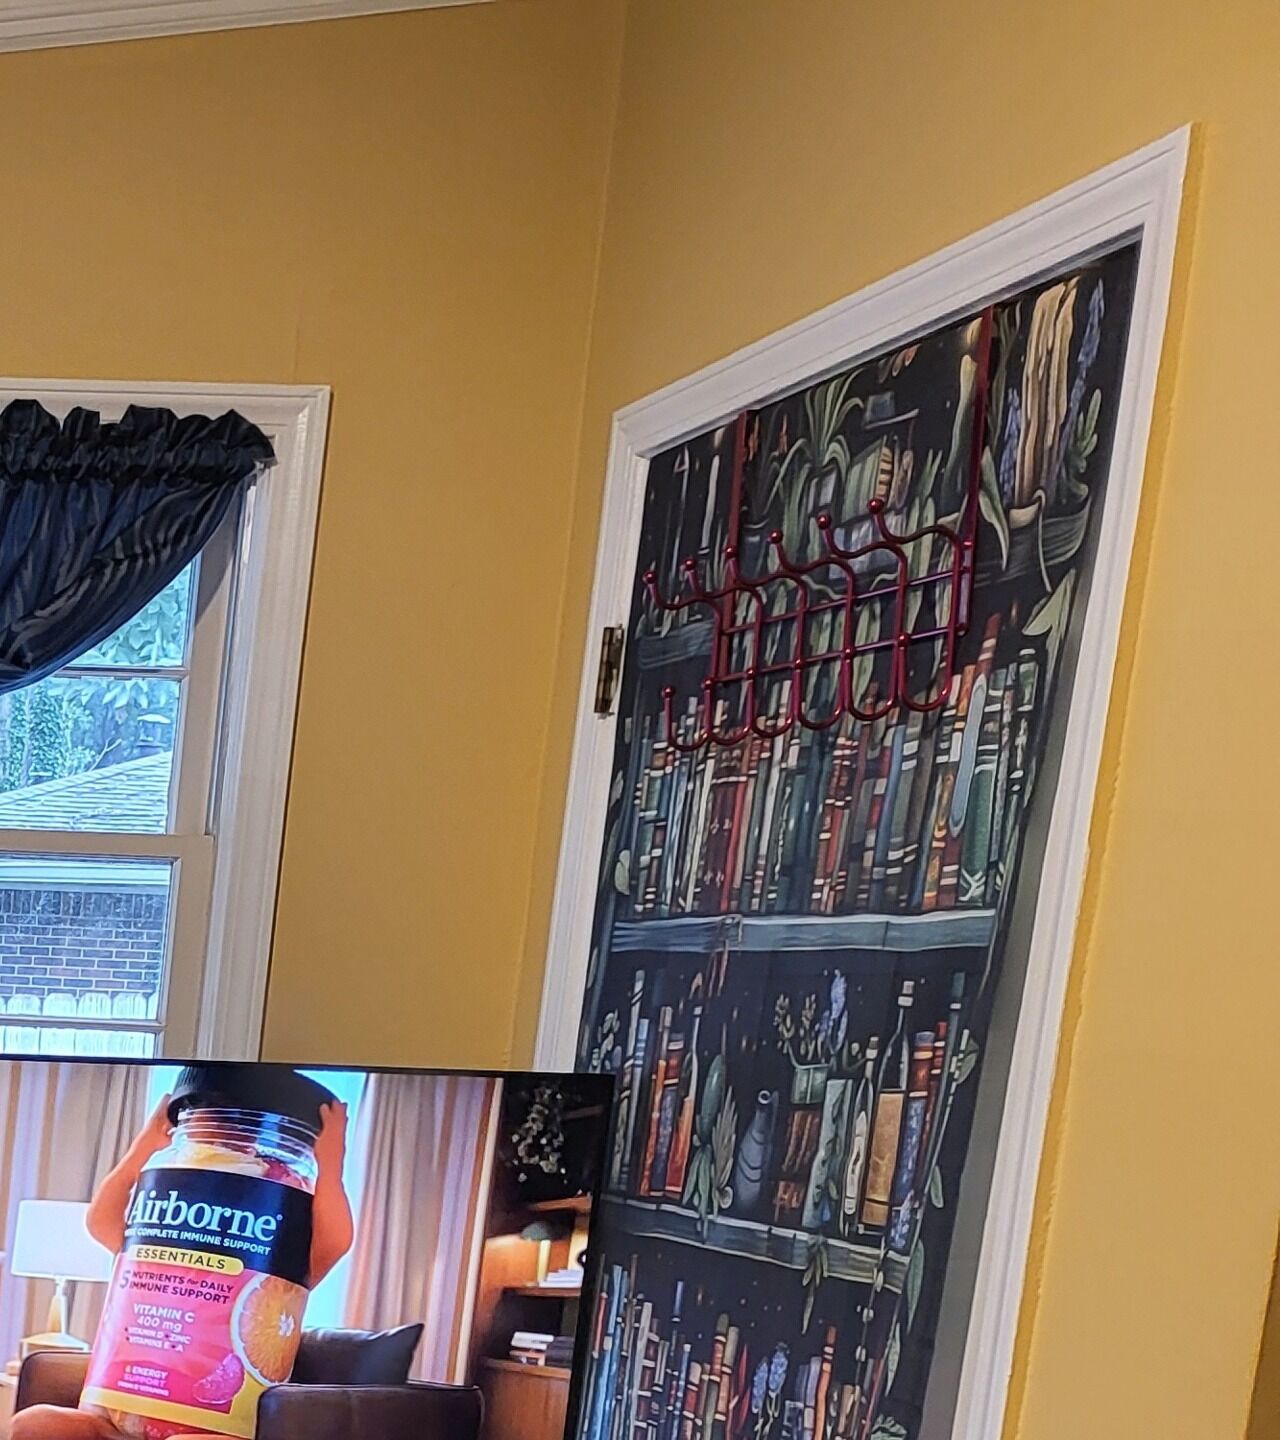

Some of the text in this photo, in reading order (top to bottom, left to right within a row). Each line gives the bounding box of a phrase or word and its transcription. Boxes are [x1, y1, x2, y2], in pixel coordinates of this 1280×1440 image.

[127, 1190, 277, 1241] Airborne
[137, 1228, 179, 1239] COMPLETE
[180, 1231, 222, 1245] IMMUNE
[223, 1238, 271, 1256] SUPPORT
[136, 1247, 226, 1269] ESSENTIALS
[120, 1270, 131, 1289] 5
[133, 1271, 185, 1284] NUTRIENTS
[200, 1280, 234, 1293] DAILY
[129, 1281, 230, 1305] IMMUNE SUPPORT
[134, 1304, 195, 1323] VITAMIN C
[137, 1316, 182, 1333] 400 mg
[169, 1333, 192, 1344] ZINC
[132, 1366, 169, 1379] ENERGY
